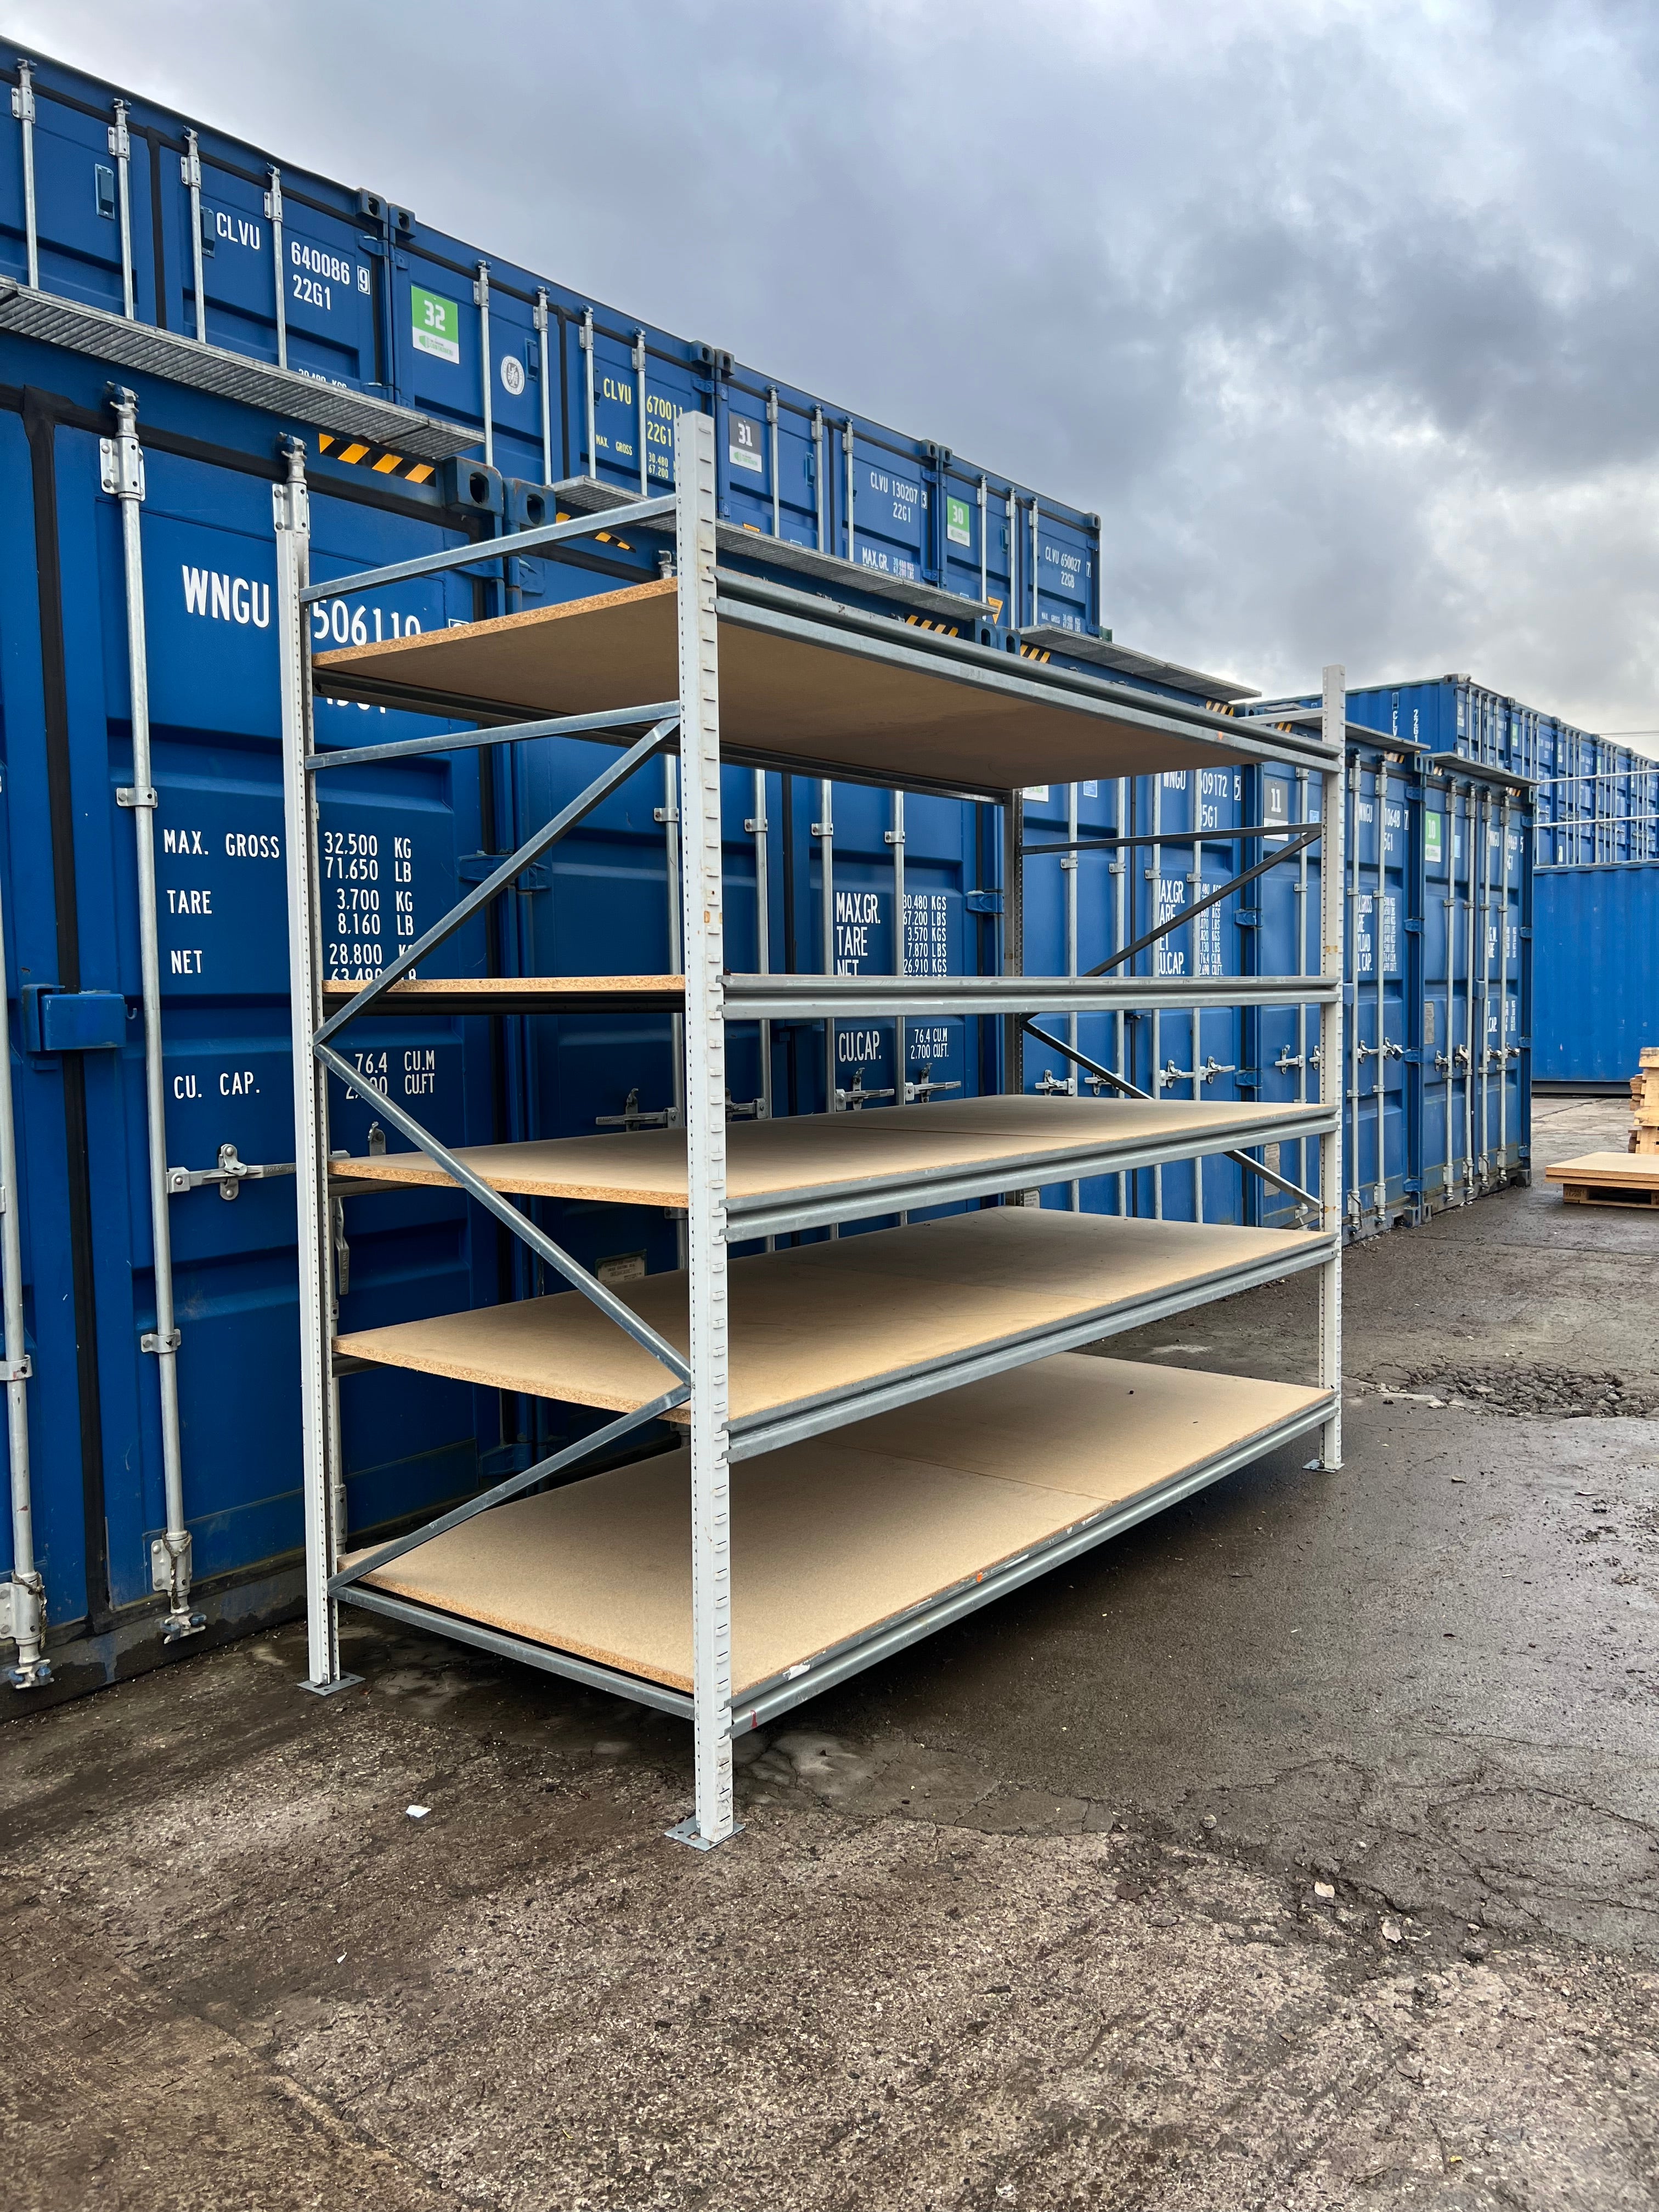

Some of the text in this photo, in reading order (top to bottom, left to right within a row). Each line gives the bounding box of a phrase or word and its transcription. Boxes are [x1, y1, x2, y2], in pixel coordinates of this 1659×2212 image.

[216, 212, 260, 250] CLVU
[291, 241, 369, 294] 640086 9
[292, 274, 331, 311] 22G1
[424, 300, 445, 331] 32
[603, 377, 631, 405] CLVU
[647, 421, 672, 447] 22G1
[737, 422, 753, 447] 31
[615, 441, 633, 456] GROSS
[648, 452, 669, 468] 30.480
[648, 464, 669, 479] 67.200
[870, 471, 927, 509] CLVU 130207 3
[893, 501, 911, 523] 22G1
[952, 505, 964, 525] 30
[862, 547, 889, 572] MAX.GR.
[1045, 546, 1059, 565] CLVU
[1060, 552, 1081, 573] 650027
[182, 564, 270, 629] WNGU
[1163, 770, 1240, 800] WNGU 09172 5
[1271, 788, 1282, 813] 11
[1200, 804, 1217, 829] 5G1
[1427, 819, 1436, 840] 10
[163, 829, 209, 855] MAX.
[225, 833, 280, 859] GROSS
[394, 837, 411, 859] KG
[395, 861, 412, 883] LB
[166, 889, 212, 915] TARE
[396, 890, 413, 912] KG
[1159, 879, 1186, 904] AX.GR.
[836, 892, 881, 924] MAX.GR.
[931, 895, 947, 911] KGS
[932, 911, 947, 927] LBS
[397, 915, 414, 935] LB
[836, 926, 947, 956] TARE 3.570 KGS
[908, 942, 947, 958] 7.870 LBS
[170, 950, 202, 974] NET
[904, 958, 929, 973] 26.910
[932, 958, 947, 973] KGS
[1158, 951, 1186, 975] U.CAP.
[838, 1028, 948, 1063] CU.CAP. 76.4 CU.M
[911, 1044, 930, 1060] 2.700
[173, 1050, 435, 1099] CU. CAP. 76.4 CU.M
[404, 1073, 435, 1095] CU.FT
